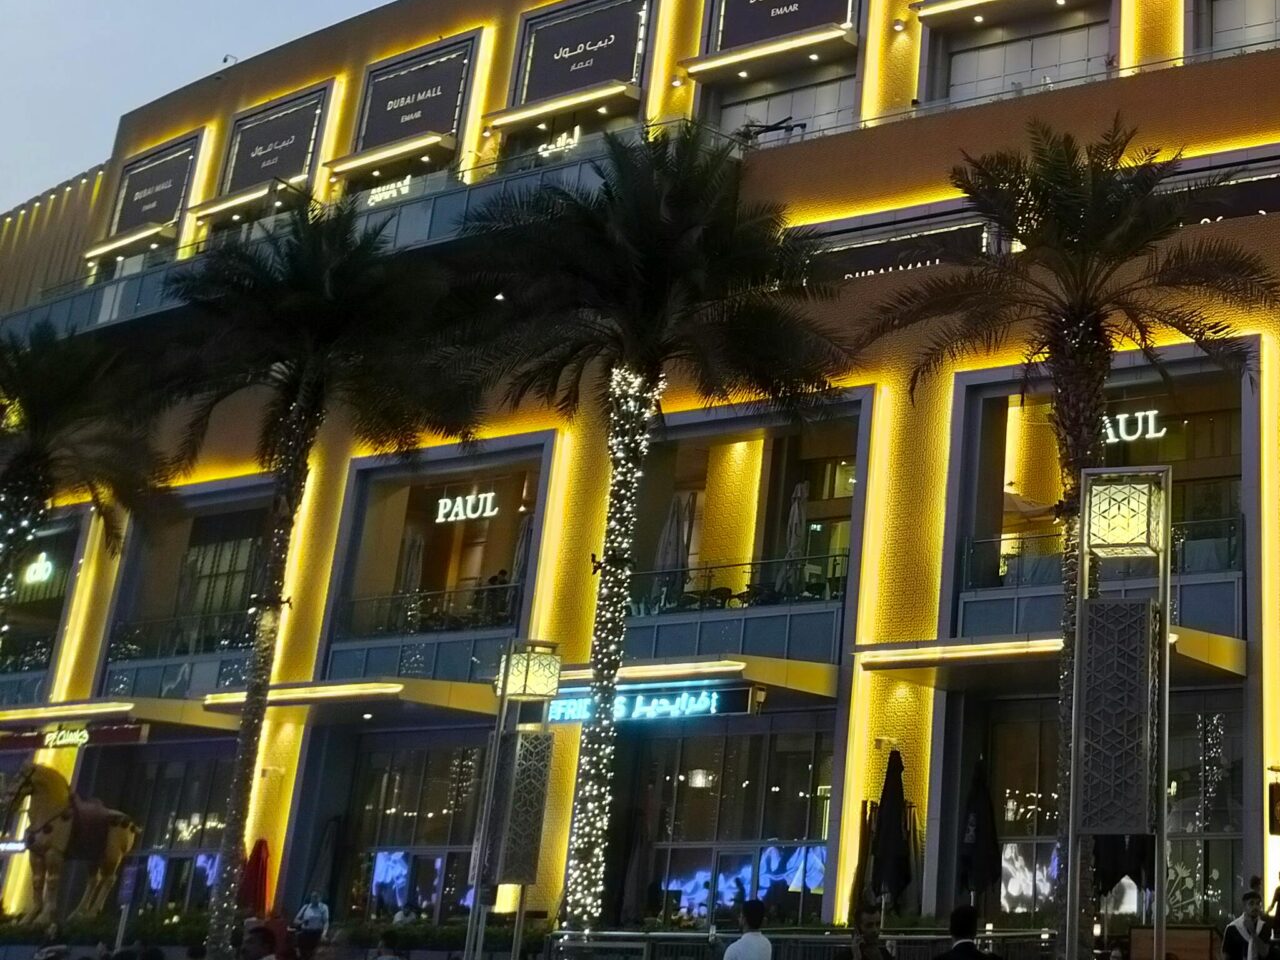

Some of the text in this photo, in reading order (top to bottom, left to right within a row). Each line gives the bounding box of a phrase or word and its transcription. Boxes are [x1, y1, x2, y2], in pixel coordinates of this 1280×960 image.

[770, 3, 799, 17] EMAAR
[386, 85, 442, 111] DUBAI MALL
[1102, 409, 1167, 444] AUL
[435, 491, 500, 524] PAUL
